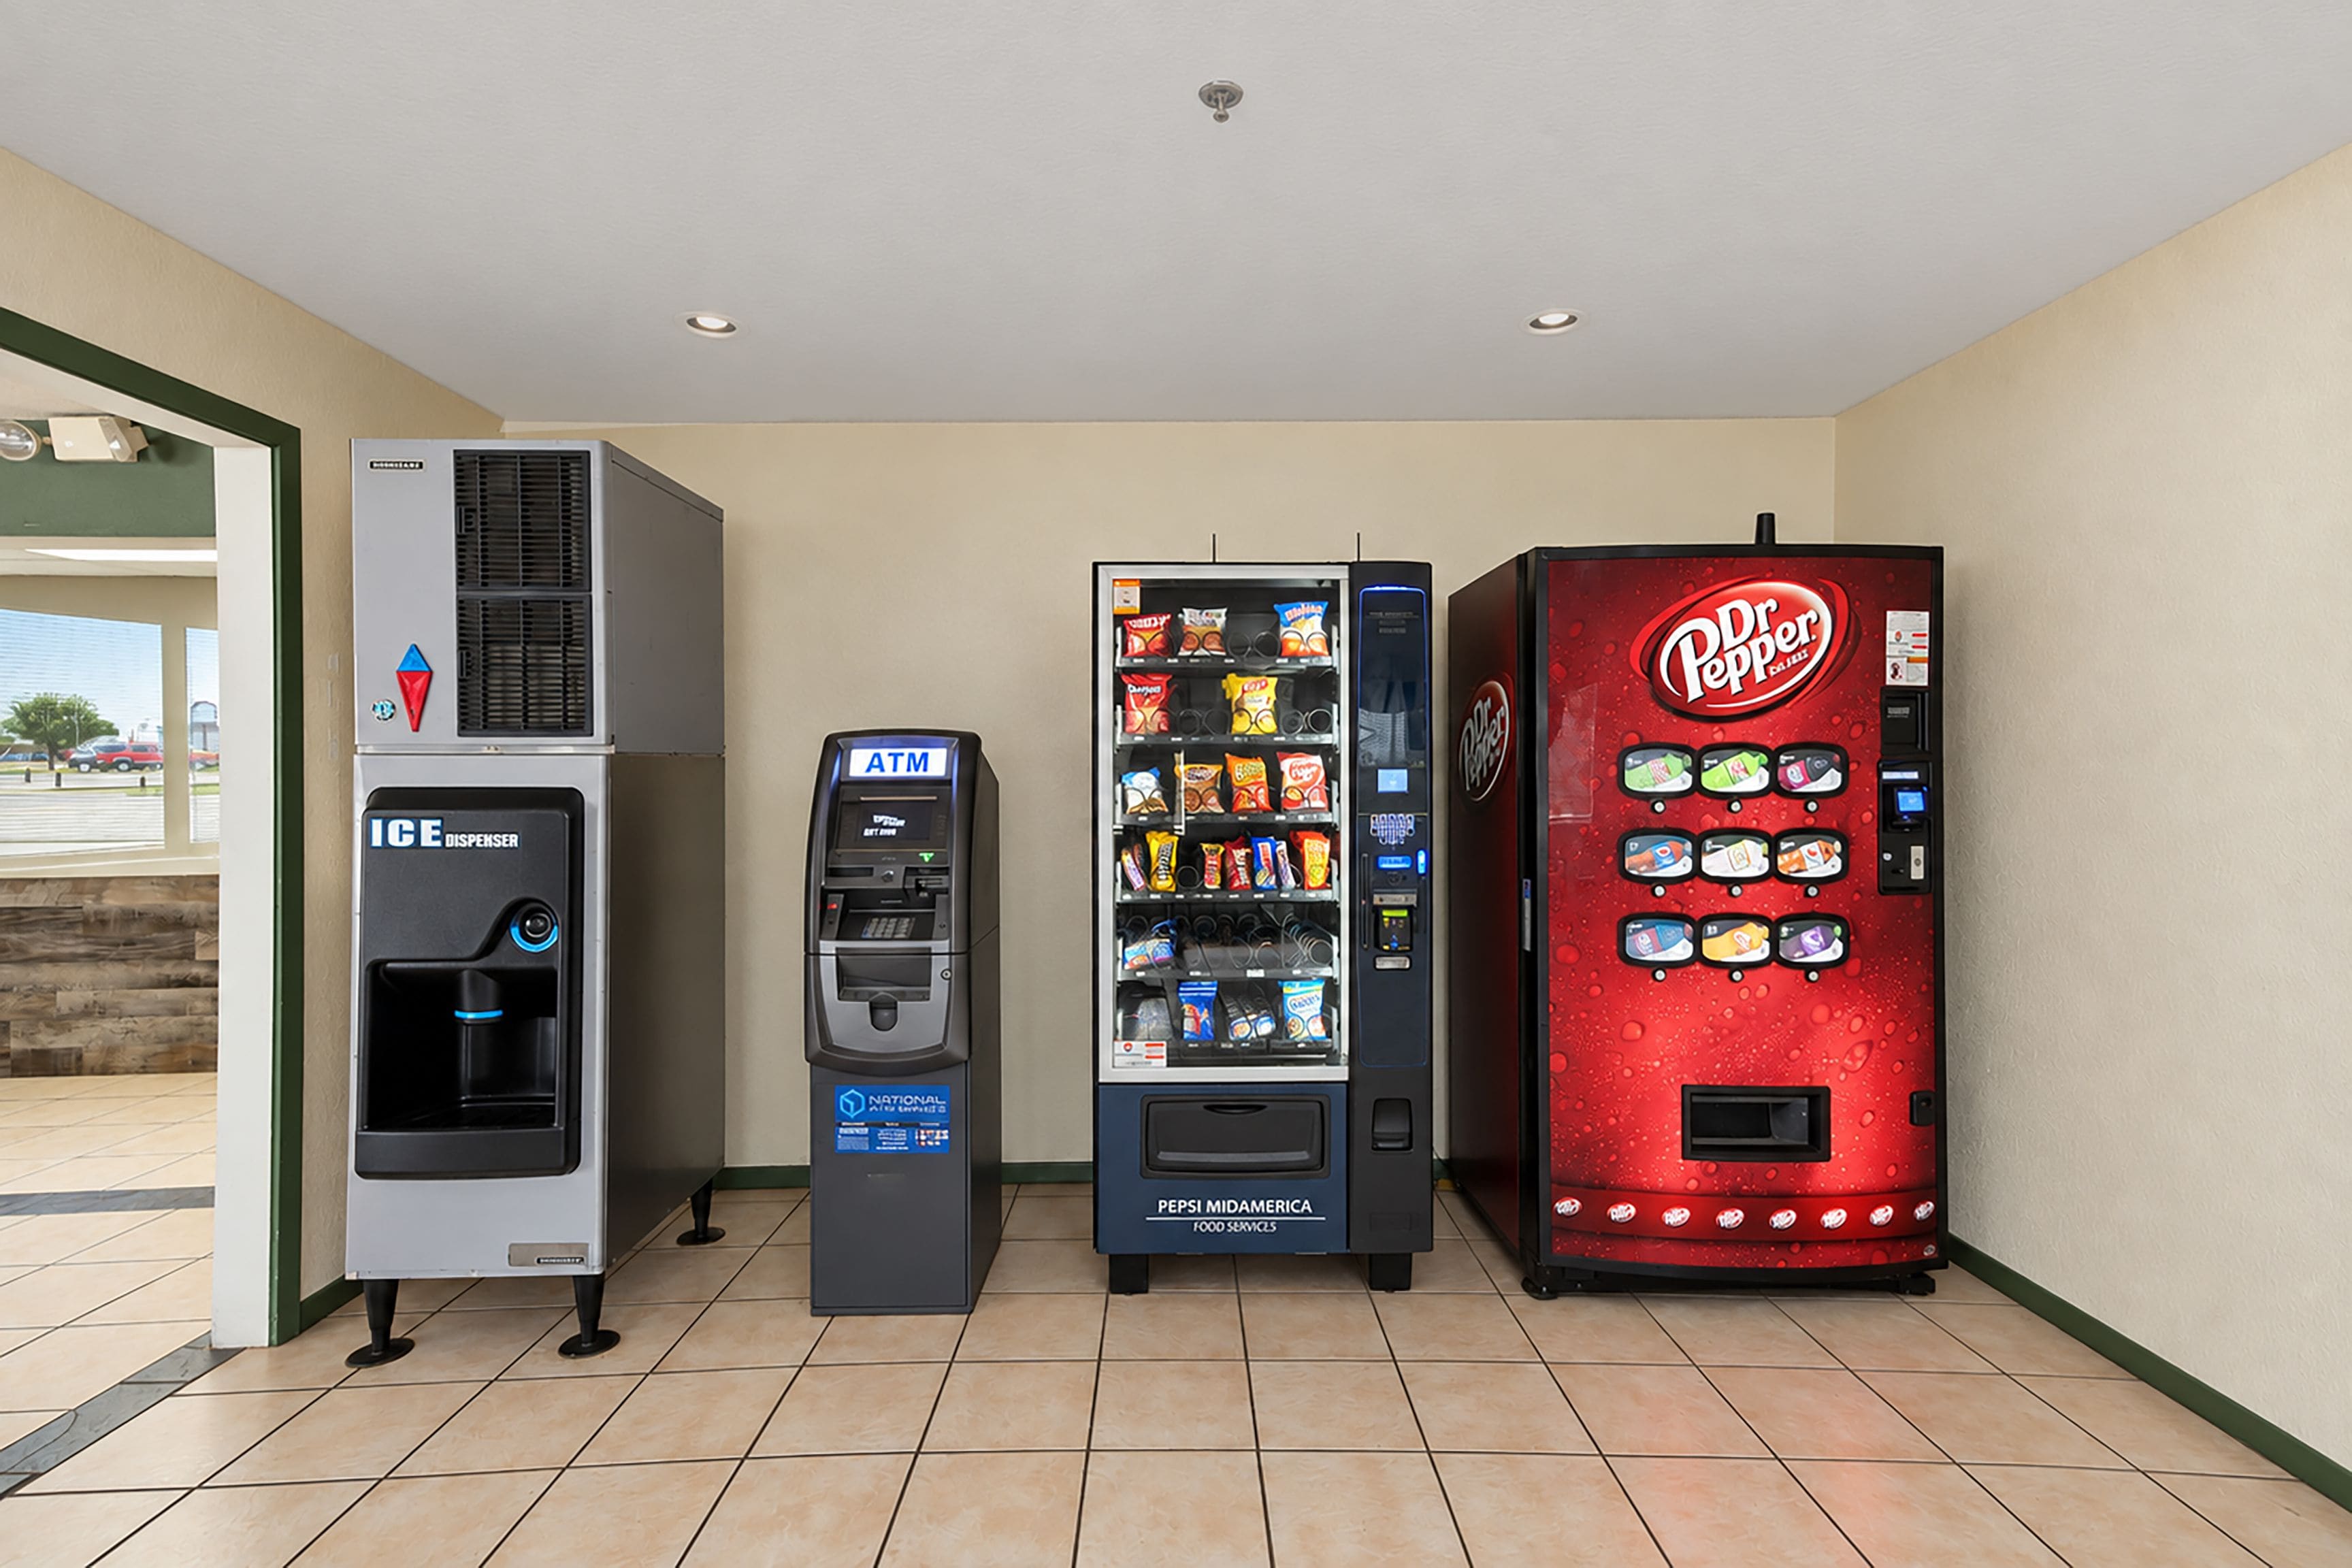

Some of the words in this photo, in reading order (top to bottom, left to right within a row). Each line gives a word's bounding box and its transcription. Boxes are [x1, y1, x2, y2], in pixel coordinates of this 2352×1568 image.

[1715, 598, 1778, 652] Dr
[865, 752, 929, 772] ATM
[371, 819, 442, 847] ICE
[445, 834, 519, 847] DISPENSER
[869, 1094, 947, 1105] NATIONAL
[1158, 1199, 1202, 1213] PEPSI
[1205, 1199, 1313, 1213] MIDAMERICA
[1193, 1221, 1225, 1232] FOOD
